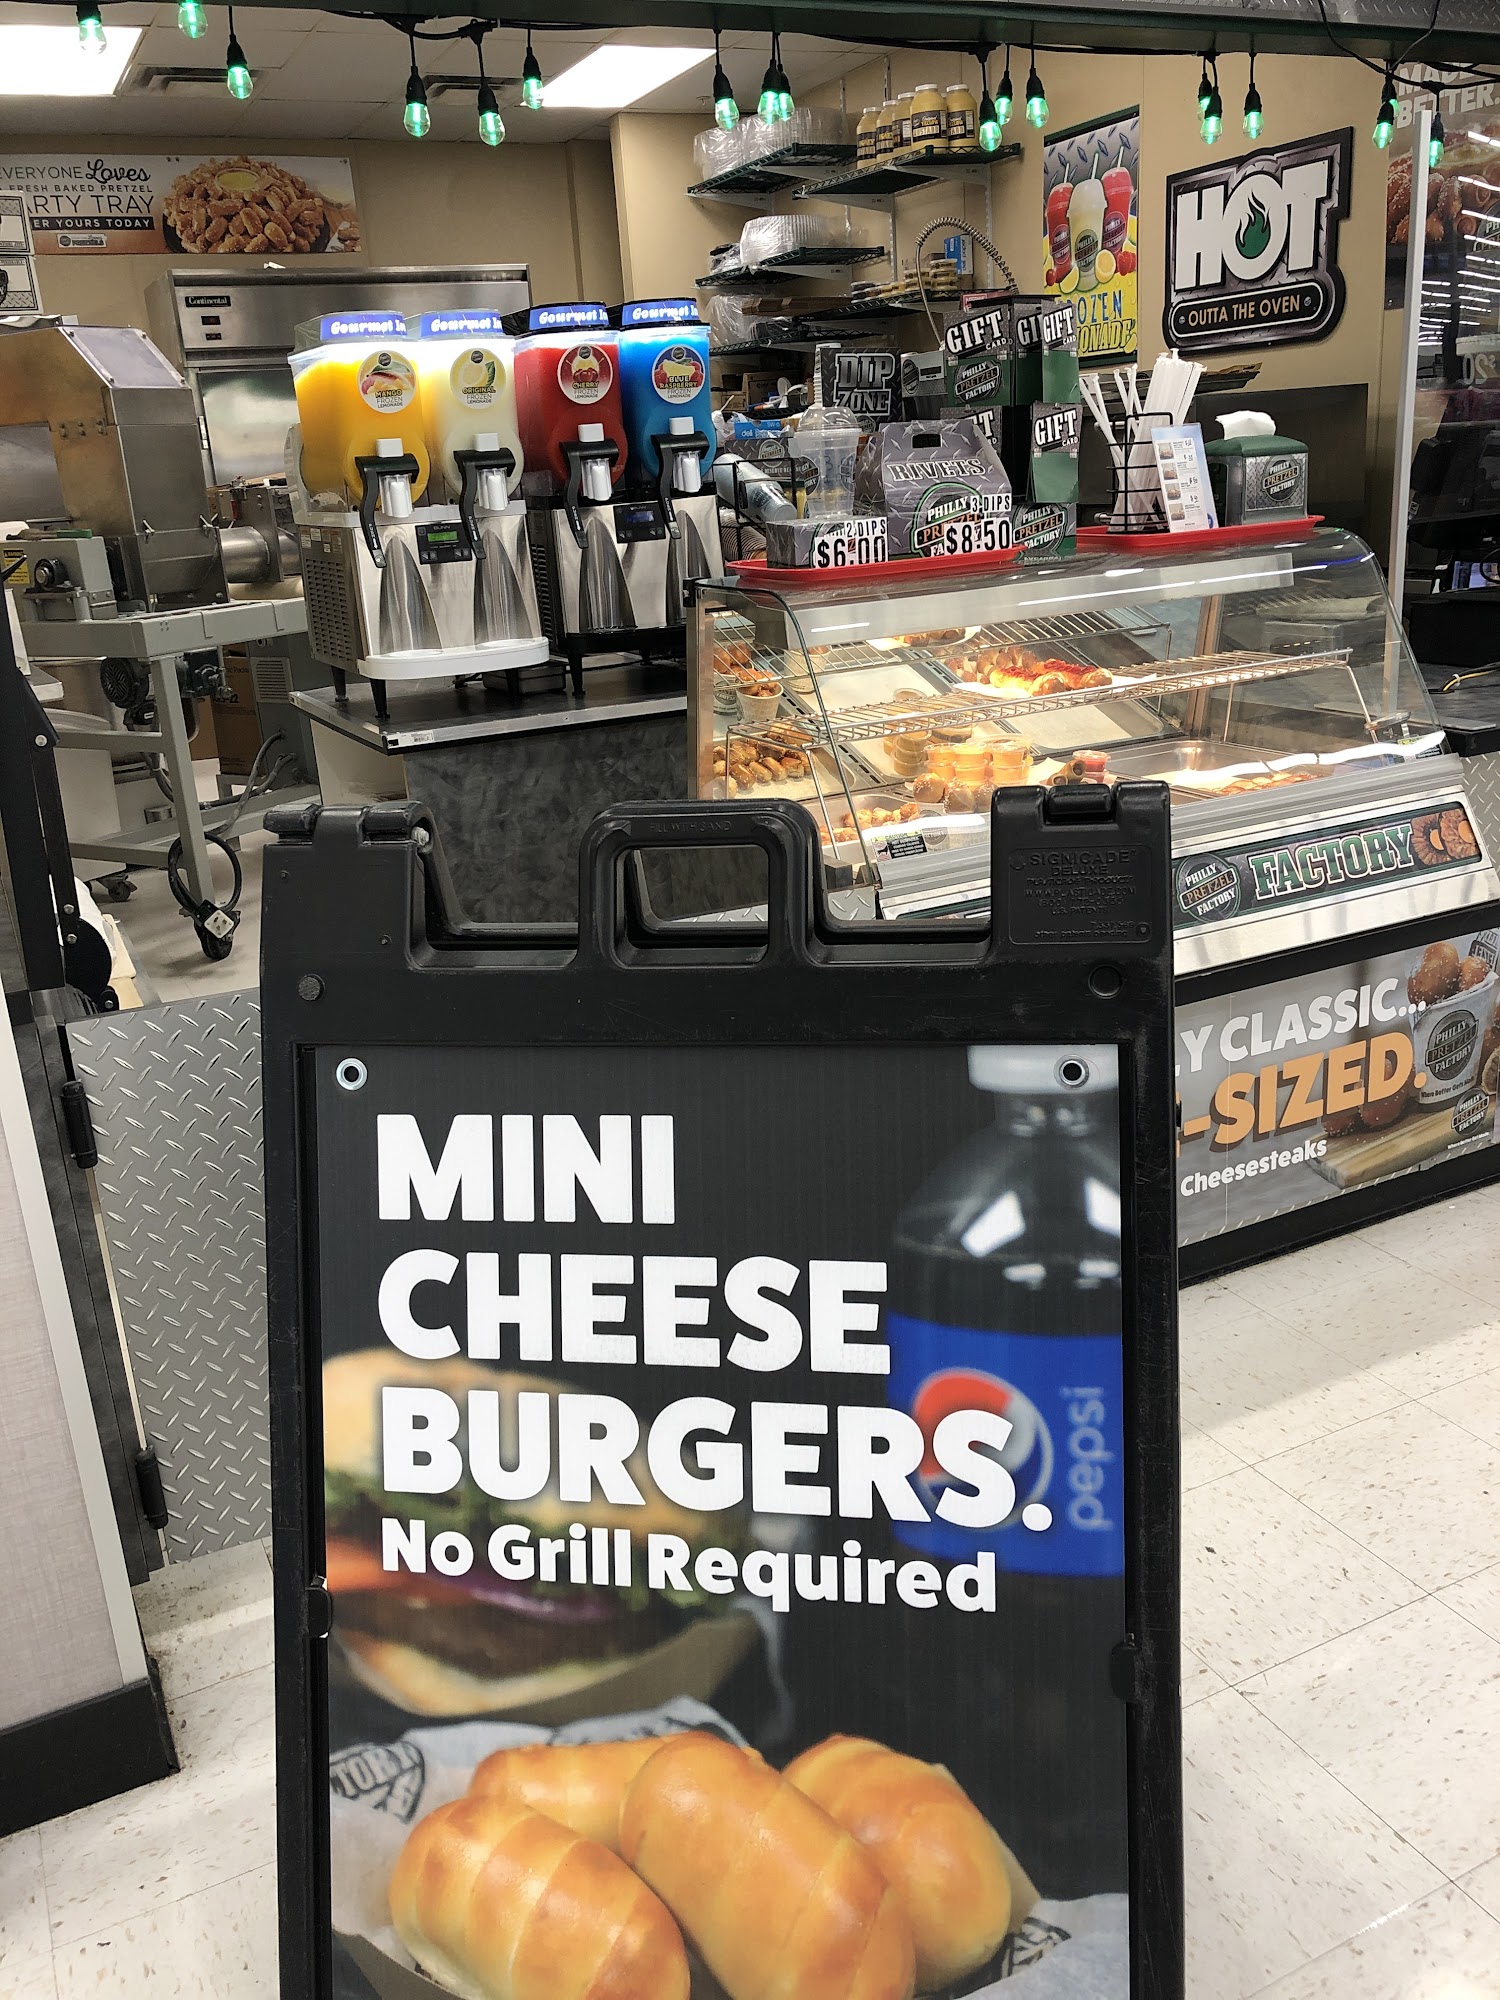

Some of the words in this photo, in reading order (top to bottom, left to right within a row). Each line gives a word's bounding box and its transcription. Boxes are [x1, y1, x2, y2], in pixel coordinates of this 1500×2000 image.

[85, 158, 151, 184] Loves
[27, 195, 81, 213] RTY
[90, 195, 154, 213] TRAY
[56, 219, 100, 227] YOURS
[107, 219, 150, 227] TODAY
[1174, 159, 1329, 292] HOT
[539, 310, 597, 325] Gourmet
[632, 305, 688, 320] Gourmet
[1066, 289, 1122, 325] OZEN
[1188, 306, 1228, 326] OUTTA
[1232, 301, 1255, 320] THE
[1259, 294, 1300, 316] OVEN
[331, 319, 393, 335] Gourmet
[431, 317, 492, 332] Gourmet
[946, 310, 1002, 353] GIFT
[1018, 313, 1042, 346] GI
[1043, 307, 1073, 343] GIFT
[1077, 319, 1132, 352] ONADE
[985, 338, 1007, 350] CARD
[1062, 335, 1077, 345] CARD
[670, 375, 690, 383] BLUE
[838, 356, 893, 388] DIP
[959, 370, 997, 391] PRETZEL
[962, 361, 988, 379] PHILLY
[375, 389, 402, 398] MANGO
[462, 386, 496, 394] ORIGINAL
[573, 381, 599, 389] CHERRY
[660, 381, 698, 389] RASPBERRY
[964, 380, 997, 400] FACTORY
[838, 390, 888, 412] ZONE
[1035, 410, 1077, 445] GIFT
[1062, 437, 1079, 446] CARD
[887, 458, 986, 482] RIVETS
[1267, 469, 1297, 486] PRETZEL
[1270, 461, 1290, 475] PHILLY
[1270, 479, 1296, 495] FACTORY
[927, 496, 968, 522] PHILLY
[983, 495, 1011, 511] DIPS
[1022, 505, 1051, 523] PHILLY
[857, 518, 886, 537] DIPS
[946, 519, 1011, 555] $8.50
[1018, 515, 1061, 539] PRETZEL
[1024, 529, 1061, 549] FACTORY
[817, 535, 886, 569] $6.00
[700, 820, 732, 832] SAND
[1029, 850, 1130, 866] SIGNICADE
[1249, 824, 1413, 900] FACTORY
[1051, 864, 1108, 876] DELUXE
[1185, 863, 1217, 887] PHILLY
[1186, 873, 1233, 905] PRETZEL
[1196, 887, 1236, 916] FACTORY
[1436, 1018, 1468, 1044] PHILLY
[1430, 1029, 1475, 1061] PRETZEL
[1434, 1044, 1472, 1073] FACTORY
[1176, 1032, 1427, 1145] -SIZED.
[1456, 1101, 1488, 1124] PRETZEL
[1459, 1093, 1481, 1112] PHILLY
[1458, 1111, 1486, 1132] FACTORY
[376, 1114, 675, 1225] MINI
[1180, 1139, 1328, 1197] Cheesesteaks
[378, 1248, 891, 1375] CHEESE
[381, 1386, 1053, 1533] BURGERS.
[1062, 1386, 1115, 1533] pepsi
[381, 1517, 474, 1577] No
[487, 1523, 633, 1588] Grill
[647, 1533, 997, 1613] Required
